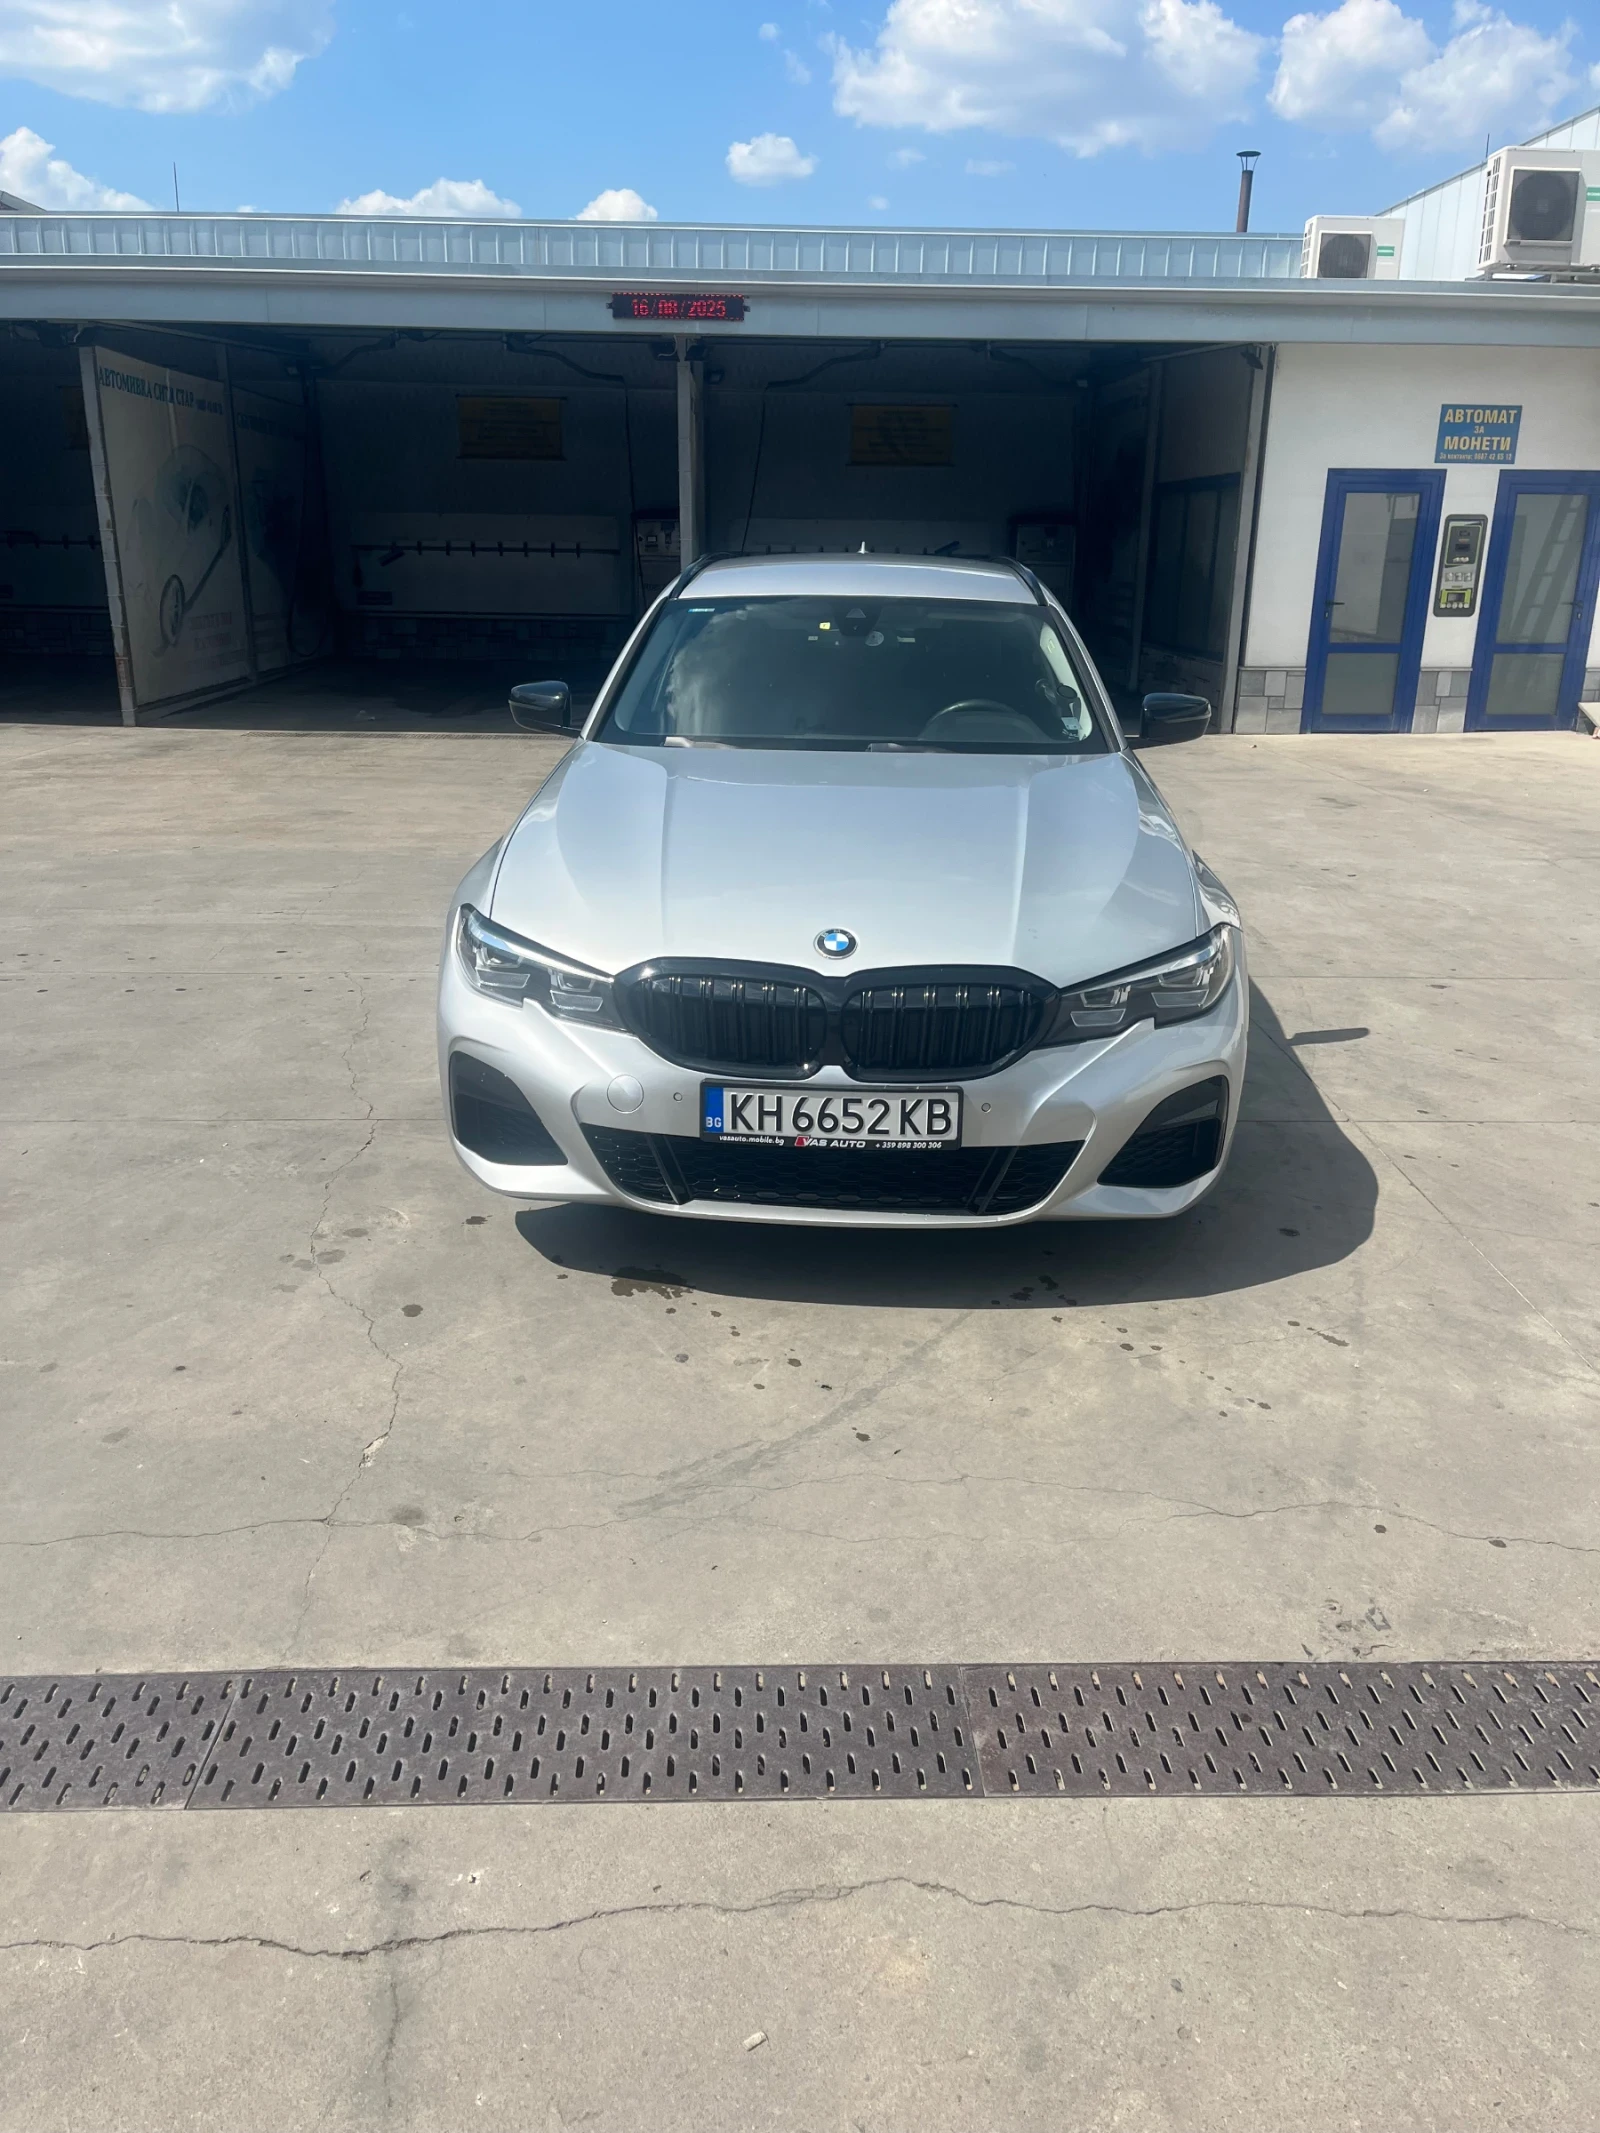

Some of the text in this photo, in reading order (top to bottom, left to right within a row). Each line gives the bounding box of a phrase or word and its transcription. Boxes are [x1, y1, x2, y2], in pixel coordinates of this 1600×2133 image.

[99, 366, 153, 399] АВТОМИВКА
[1444, 408, 1518, 424] АВТОМАТ
[1474, 425, 1485, 434] ЗА
[1443, 436, 1512, 451] МОНЕТИ
[705, 1116, 722, 1128] BG
[719, 1135, 785, 1146] vasauto.mobile.bg
[801, 1137, 867, 1148] VAS AUTO
